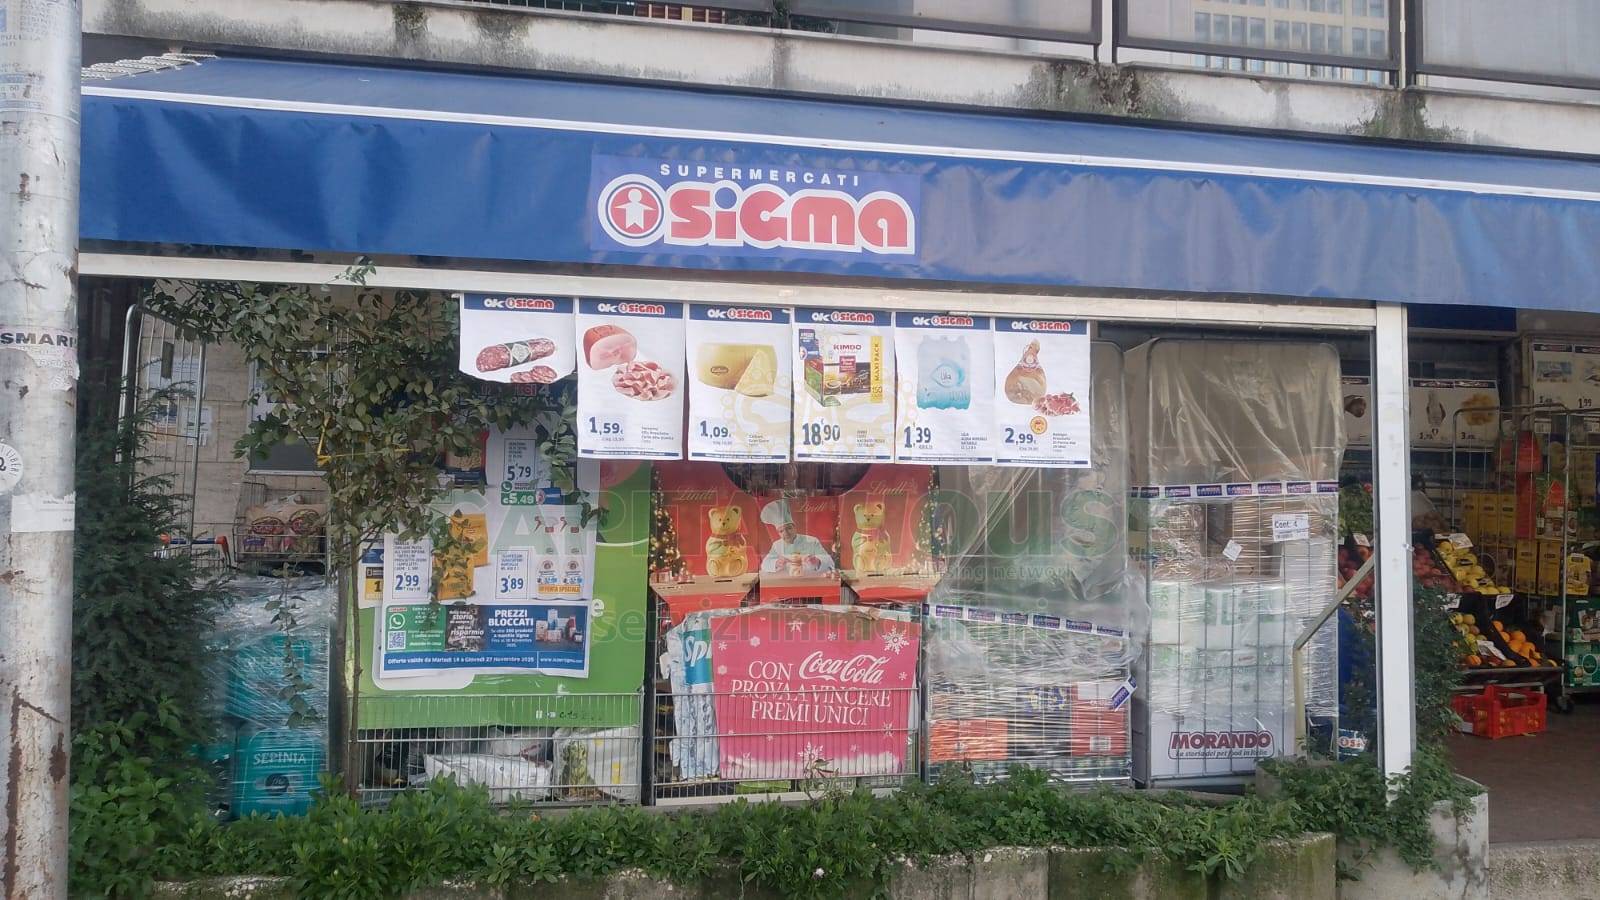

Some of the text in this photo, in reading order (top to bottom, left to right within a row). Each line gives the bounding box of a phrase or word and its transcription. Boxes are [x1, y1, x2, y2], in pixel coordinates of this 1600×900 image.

[660, 163, 859, 186] SUPERMERCATI
[870, 481, 908, 497] Lindt
[452, 613, 473, 621] storia
[494, 609, 528, 618] PREZZI
[488, 618, 534, 626] BLOCCATI
[451, 628, 484, 637] risparmio
[388, 657, 406, 665] Offerte
[494, 655, 520, 664] Novembre
[748, 660, 794, 681] CON
[730, 679, 892, 707] PROVA A VINCERE
[751, 700, 869, 726] PREMI UNICI
[1171, 732, 1271, 750] MORANDO
[1185, 749, 1205, 757] storia
[1228, 749, 1242, 757] food
